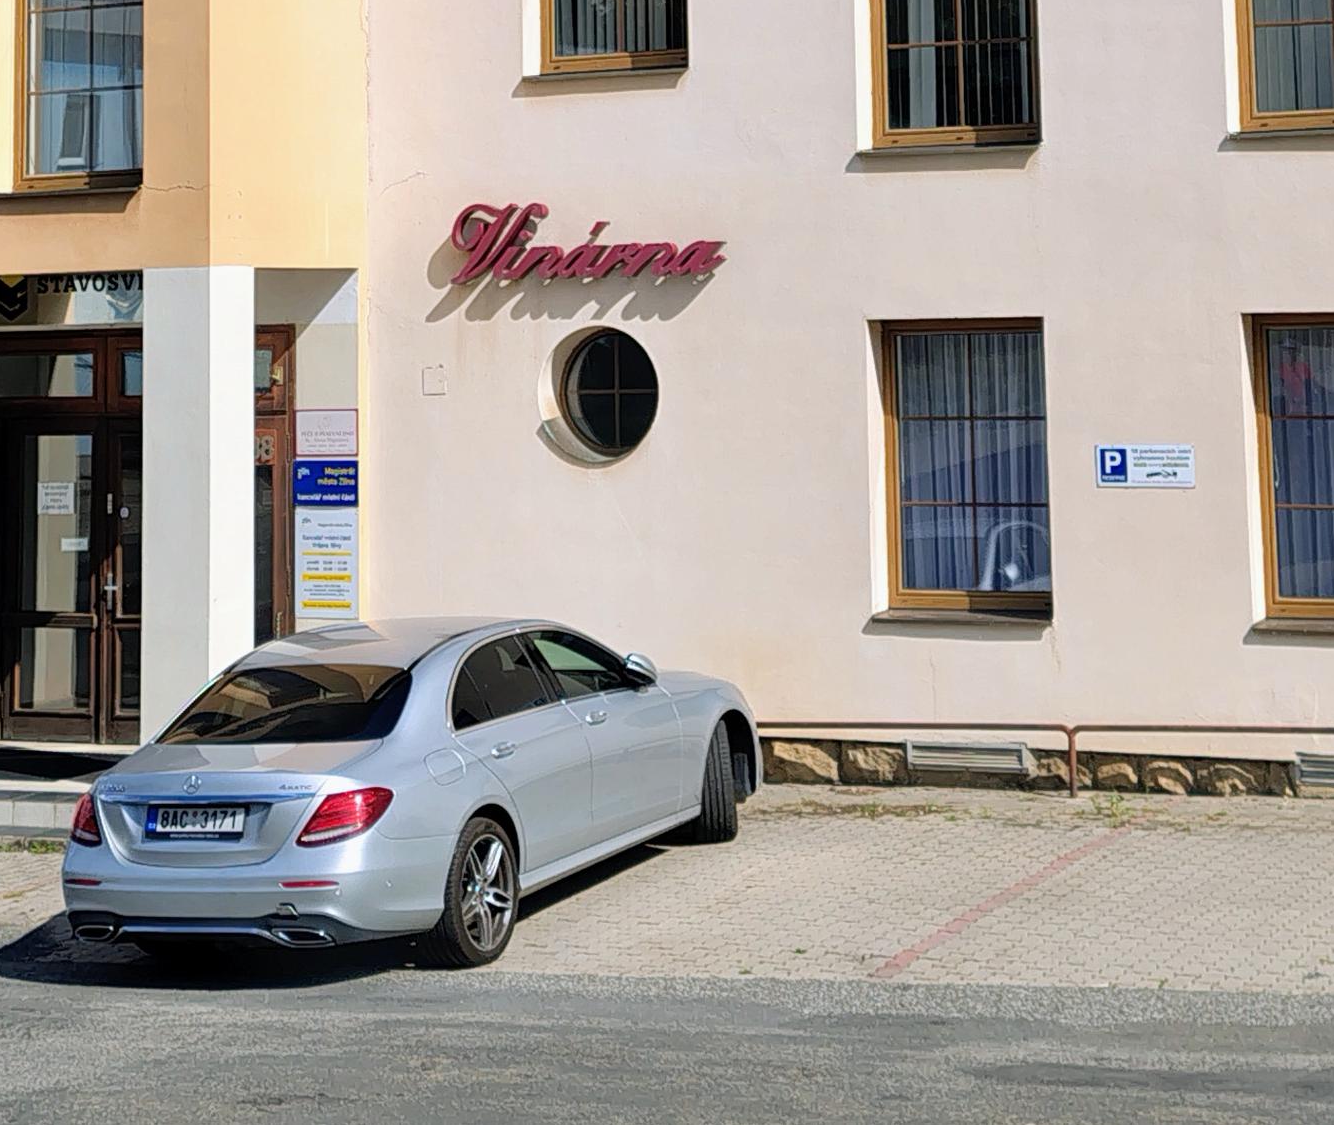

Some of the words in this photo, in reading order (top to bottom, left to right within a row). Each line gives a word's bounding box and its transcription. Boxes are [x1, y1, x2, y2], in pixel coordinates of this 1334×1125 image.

[451, 203, 728, 285] Vinárna
[1104, 451, 1122, 474] P
[160, 810, 188, 829] 8AC
[199, 810, 237, 830] 3171
